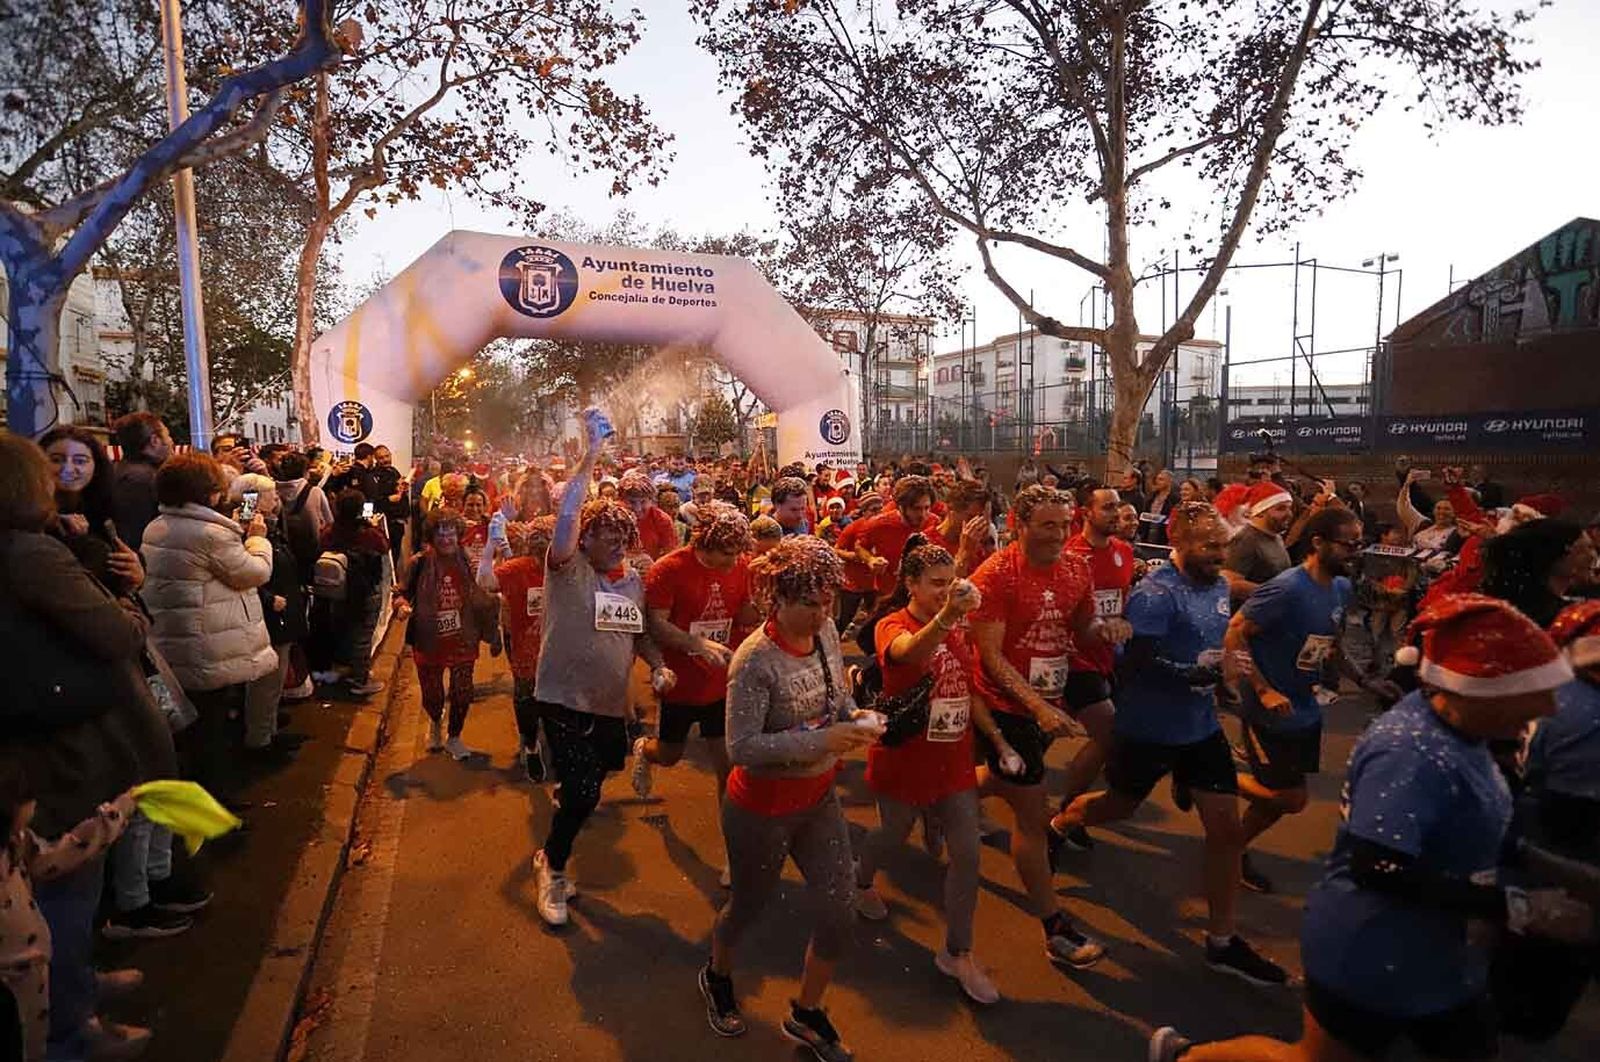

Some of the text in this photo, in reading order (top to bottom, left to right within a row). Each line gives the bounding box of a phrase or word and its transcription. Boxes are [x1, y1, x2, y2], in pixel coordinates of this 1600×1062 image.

[582, 255, 714, 278] Ayuntamiento
[621, 275, 715, 294] de Huelva
[652, 294, 666, 305] de
[669, 296, 718, 307] Deportes
[1315, 426, 1362, 436] HYUNDAI
[1410, 422, 1468, 433] HYUNDAI
[1512, 417, 1584, 431] HYUNDAI
[1246, 428, 1287, 438] HYDAI
[614, 606, 638, 622] 449
[1100, 600, 1119, 614] 137
